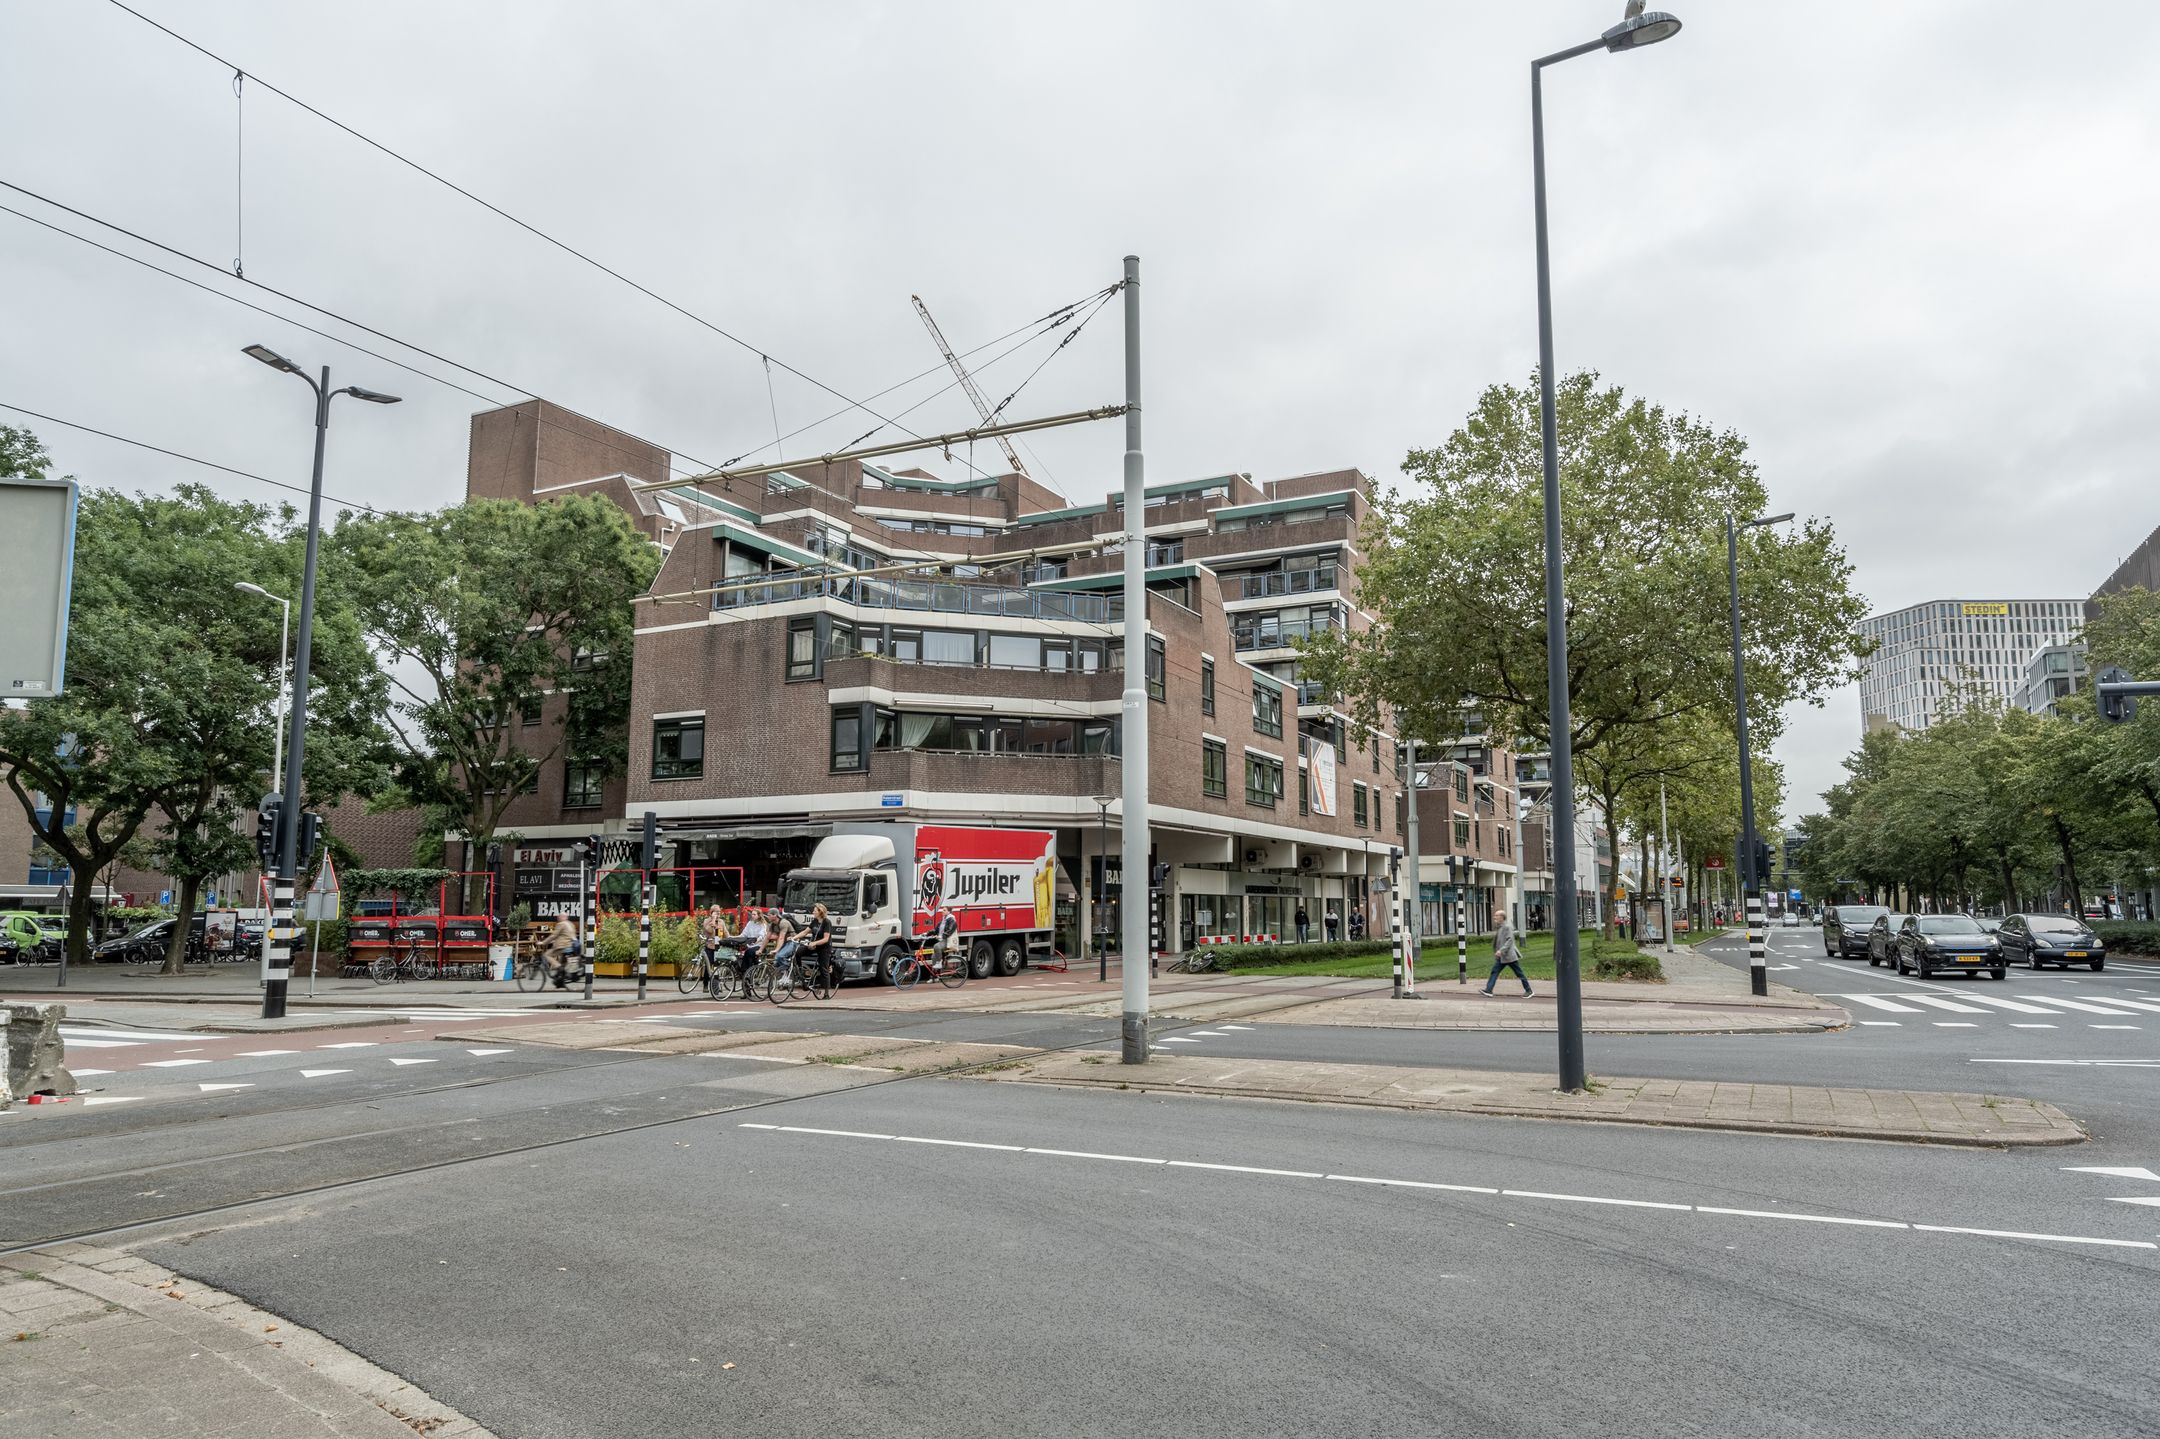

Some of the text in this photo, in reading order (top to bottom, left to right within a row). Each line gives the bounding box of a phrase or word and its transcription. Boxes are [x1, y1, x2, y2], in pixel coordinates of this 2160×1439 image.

[1964, 605, 2001, 614] STEDIN
[520, 849, 563, 862] El Aviv
[519, 875, 543, 884] EL AVI
[1105, 869, 1123, 885] BA
[947, 867, 1021, 903] Jupiler
[537, 901, 581, 917] BAEK
